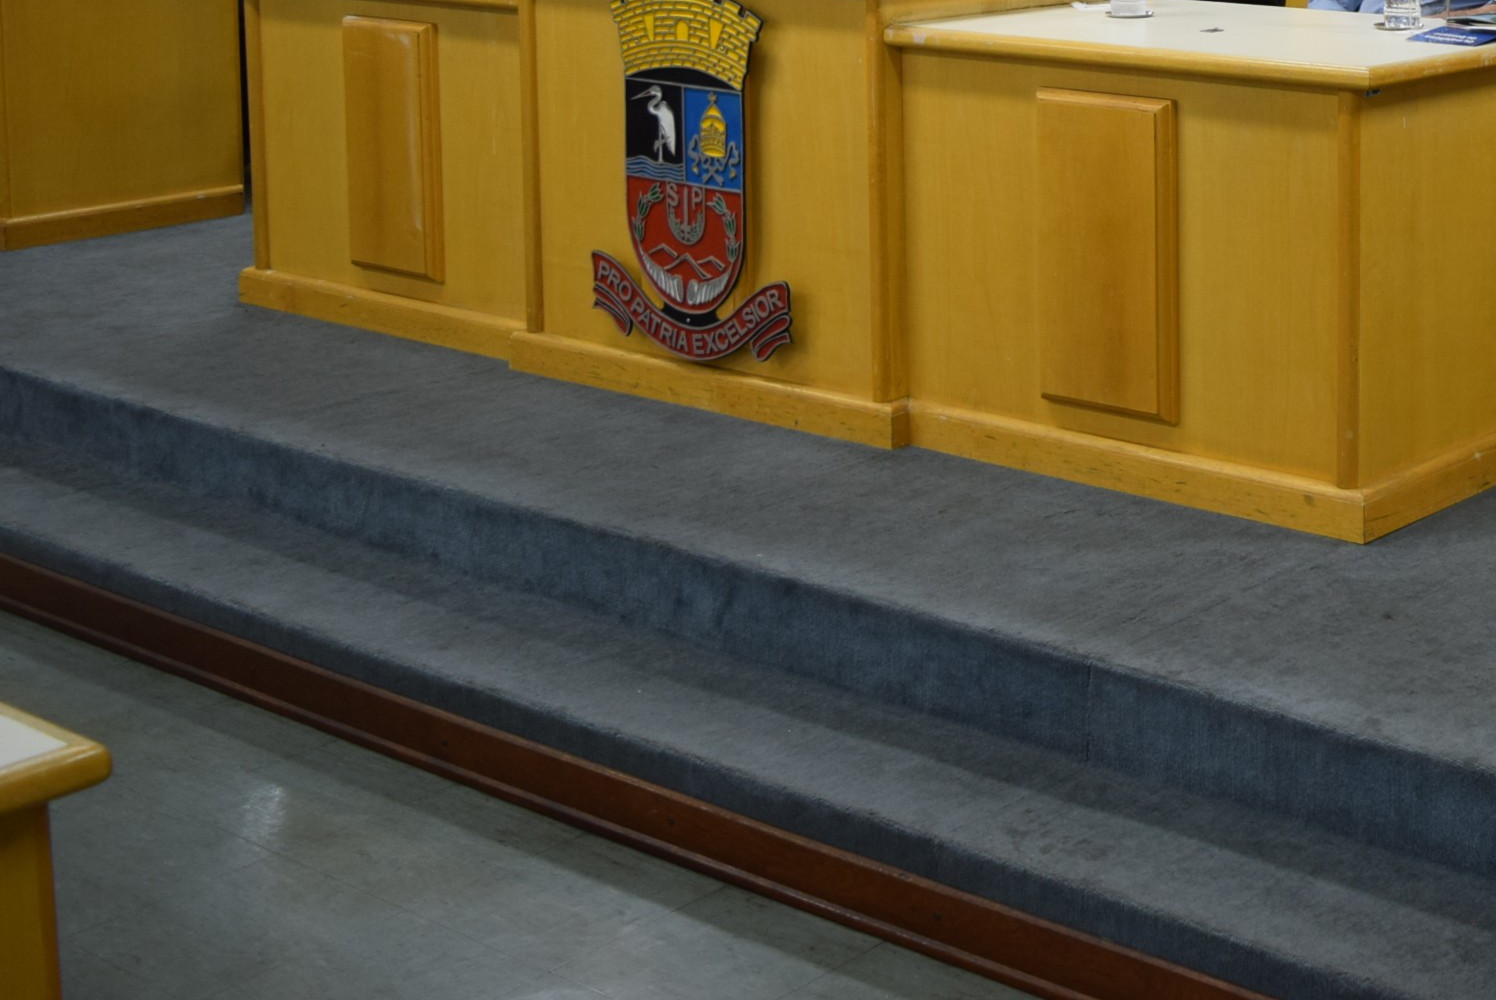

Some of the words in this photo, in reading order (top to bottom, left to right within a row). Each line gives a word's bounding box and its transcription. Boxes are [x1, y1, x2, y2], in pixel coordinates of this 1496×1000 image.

[597, 261, 632, 301] PRO
[631, 298, 689, 353] PATRIA
[692, 289, 785, 355] EXCELSIOR
